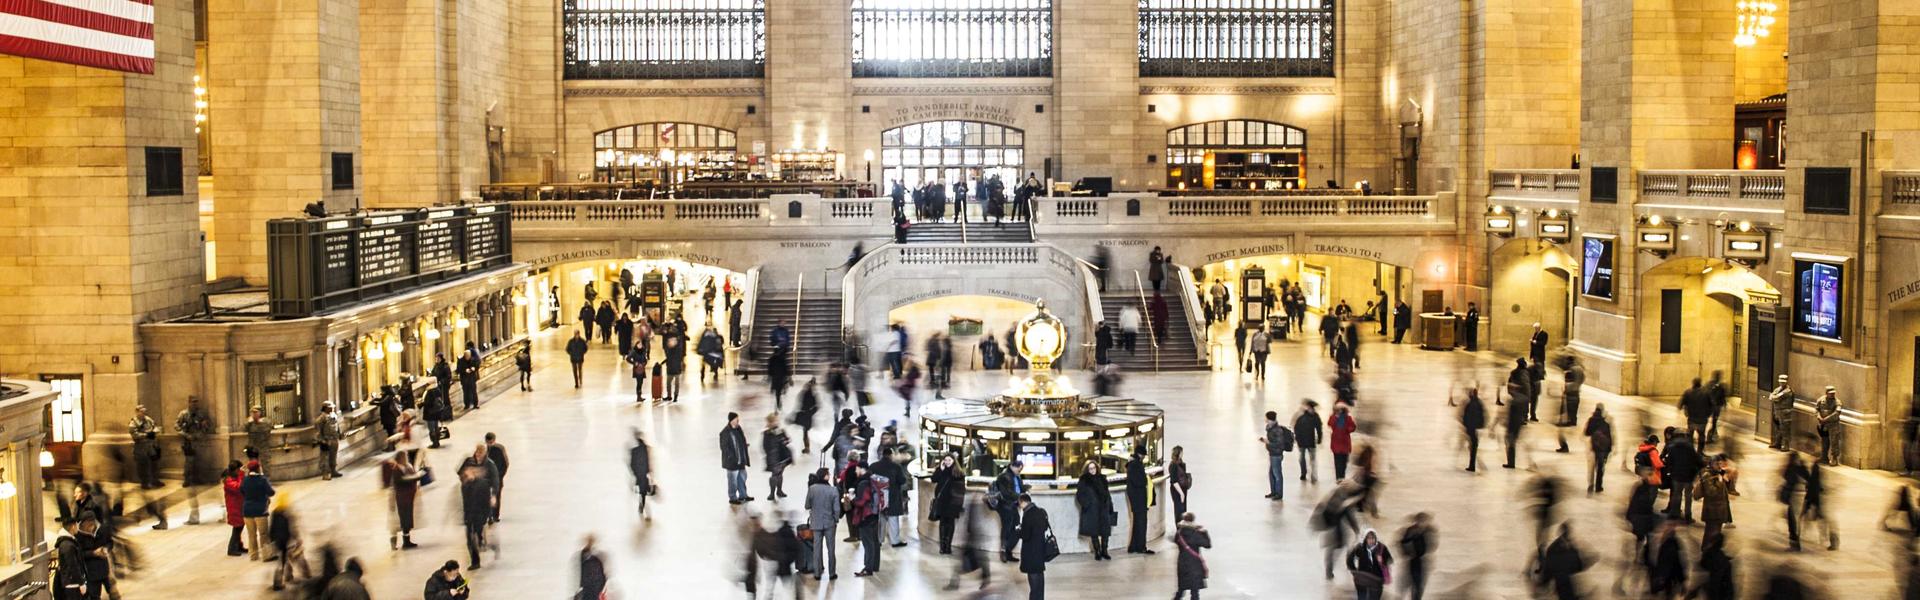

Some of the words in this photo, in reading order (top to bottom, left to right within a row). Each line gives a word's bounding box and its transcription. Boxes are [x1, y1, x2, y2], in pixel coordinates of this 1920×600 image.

[896, 108, 908, 116] TO
[913, 103, 969, 112] VANDERBILT
[975, 104, 1009, 115] AVENUE
[889, 115, 907, 125] THE
[561, 249, 611, 260] MACHINES
[641, 249, 677, 257] SUBWAY
[710, 257, 722, 265] ST
[1206, 249, 1237, 262] TICKET
[1240, 245, 1284, 256] MACHINES
[1314, 244, 1348, 254] TRACKS
[1359, 249, 1371, 257] TO
[1887, 287, 1905, 303] THE
